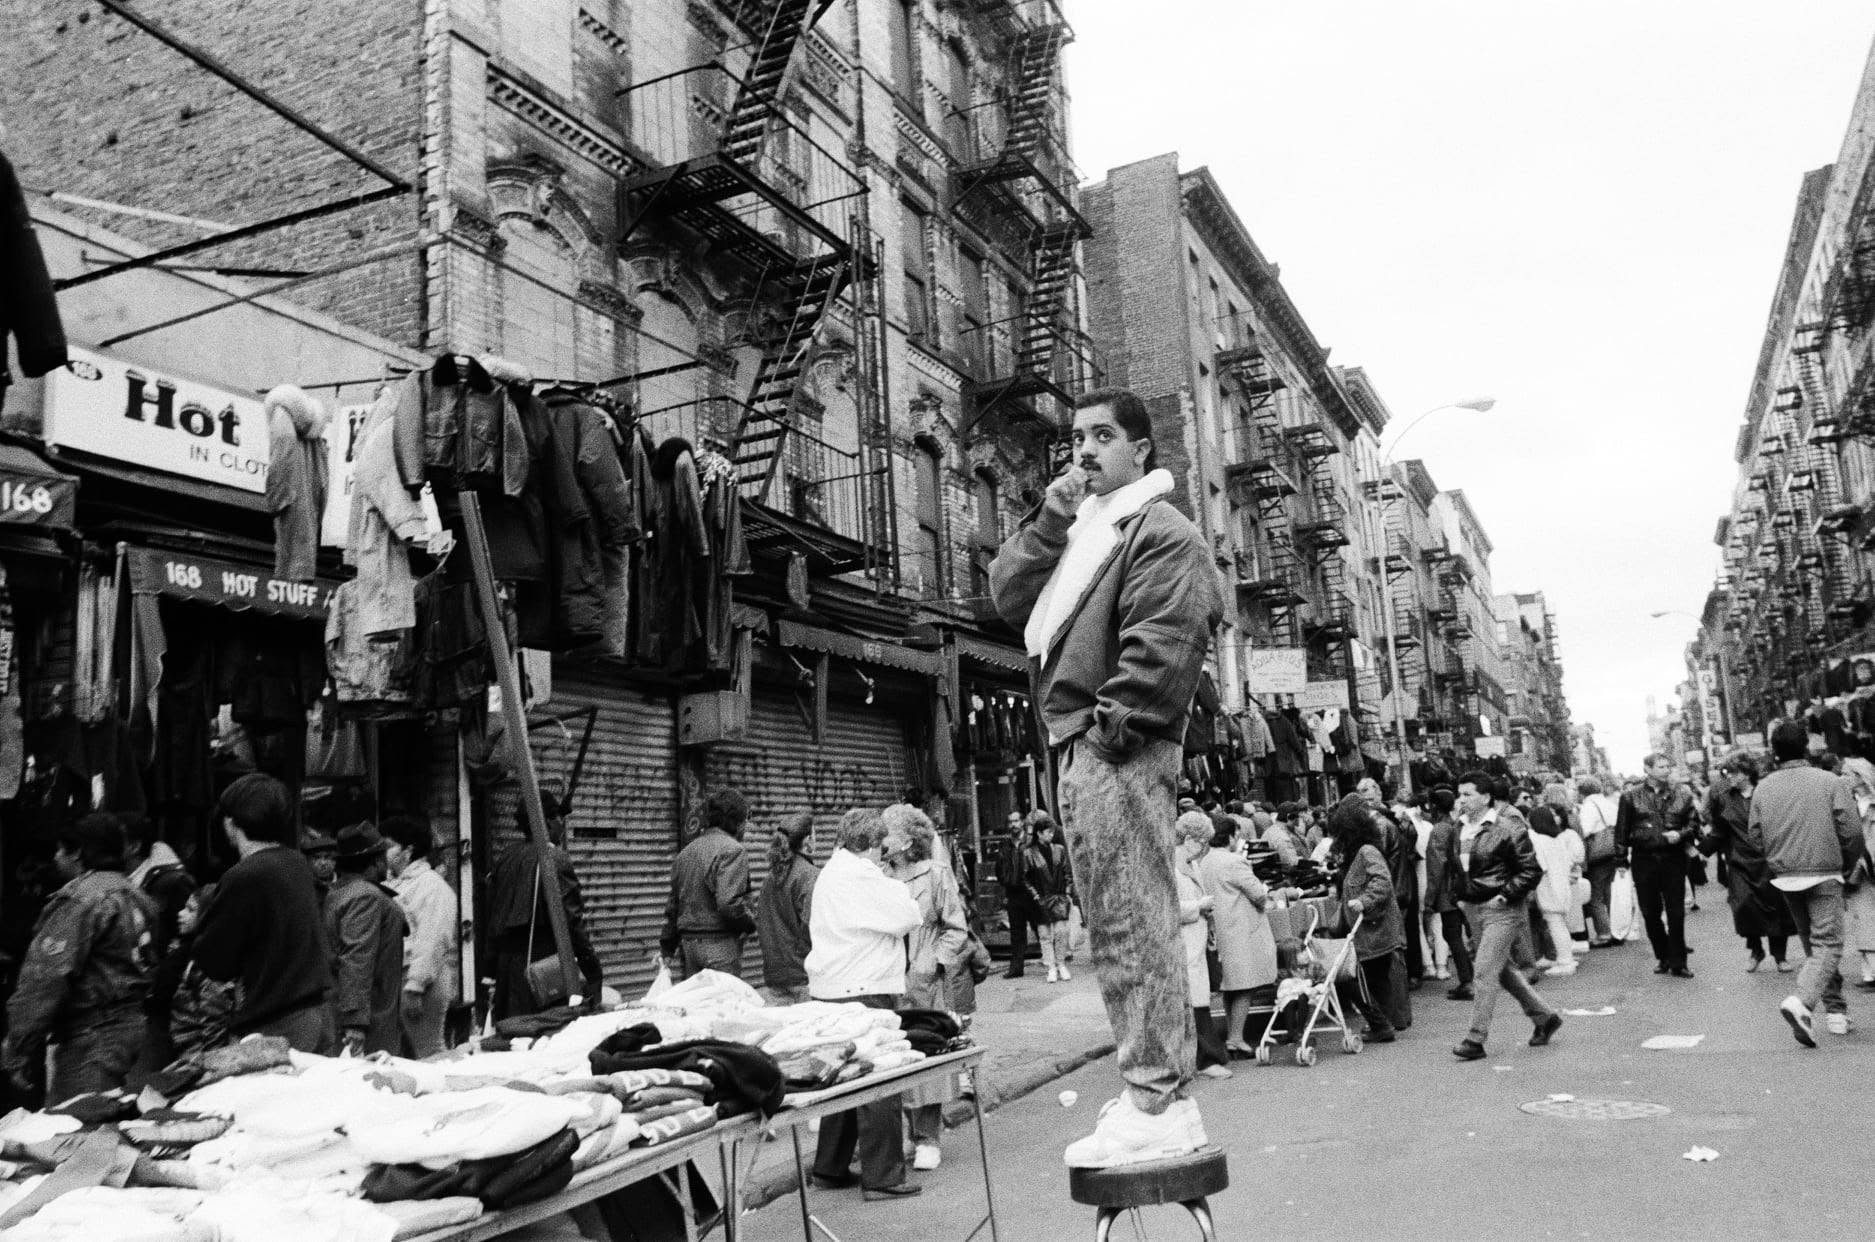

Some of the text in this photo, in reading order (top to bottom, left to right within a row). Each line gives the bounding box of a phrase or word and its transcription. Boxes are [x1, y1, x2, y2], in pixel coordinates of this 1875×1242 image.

[125, 369, 241, 447] Hot
[190, 444, 208, 462] IN
[2, 481, 53, 514] 168
[165, 561, 202, 589] 168
[222, 571, 258, 598] HOT
[267, 579, 319, 607] STUFF
